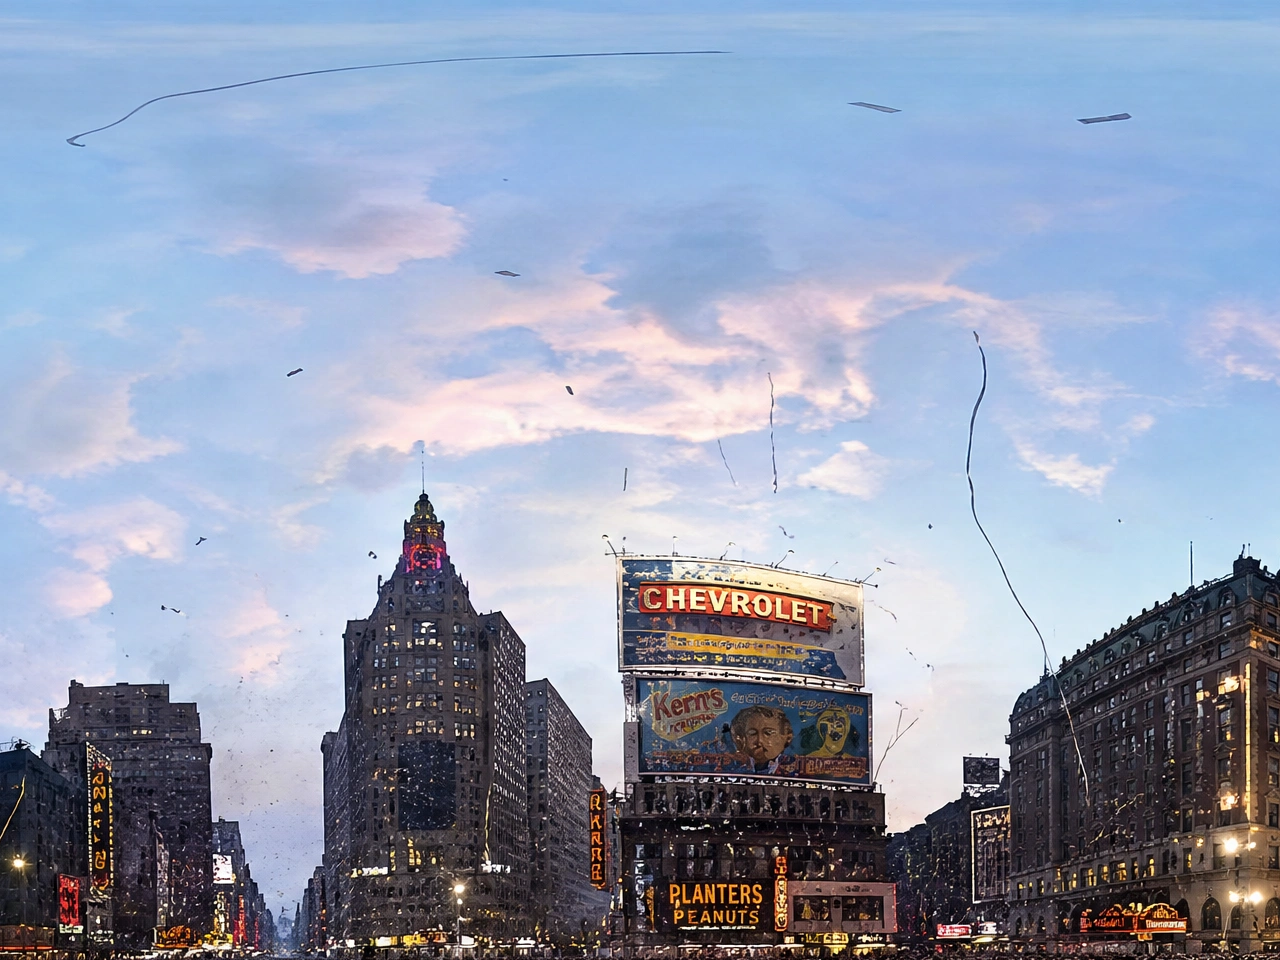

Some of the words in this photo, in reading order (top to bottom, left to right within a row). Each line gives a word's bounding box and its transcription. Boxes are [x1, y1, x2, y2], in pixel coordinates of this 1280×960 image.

[643, 588, 824, 625] CHEVROLET
[654, 688, 724, 720] Kern's
[669, 883, 763, 905] PLANTERS
[673, 909, 760, 926] PEANUTS
